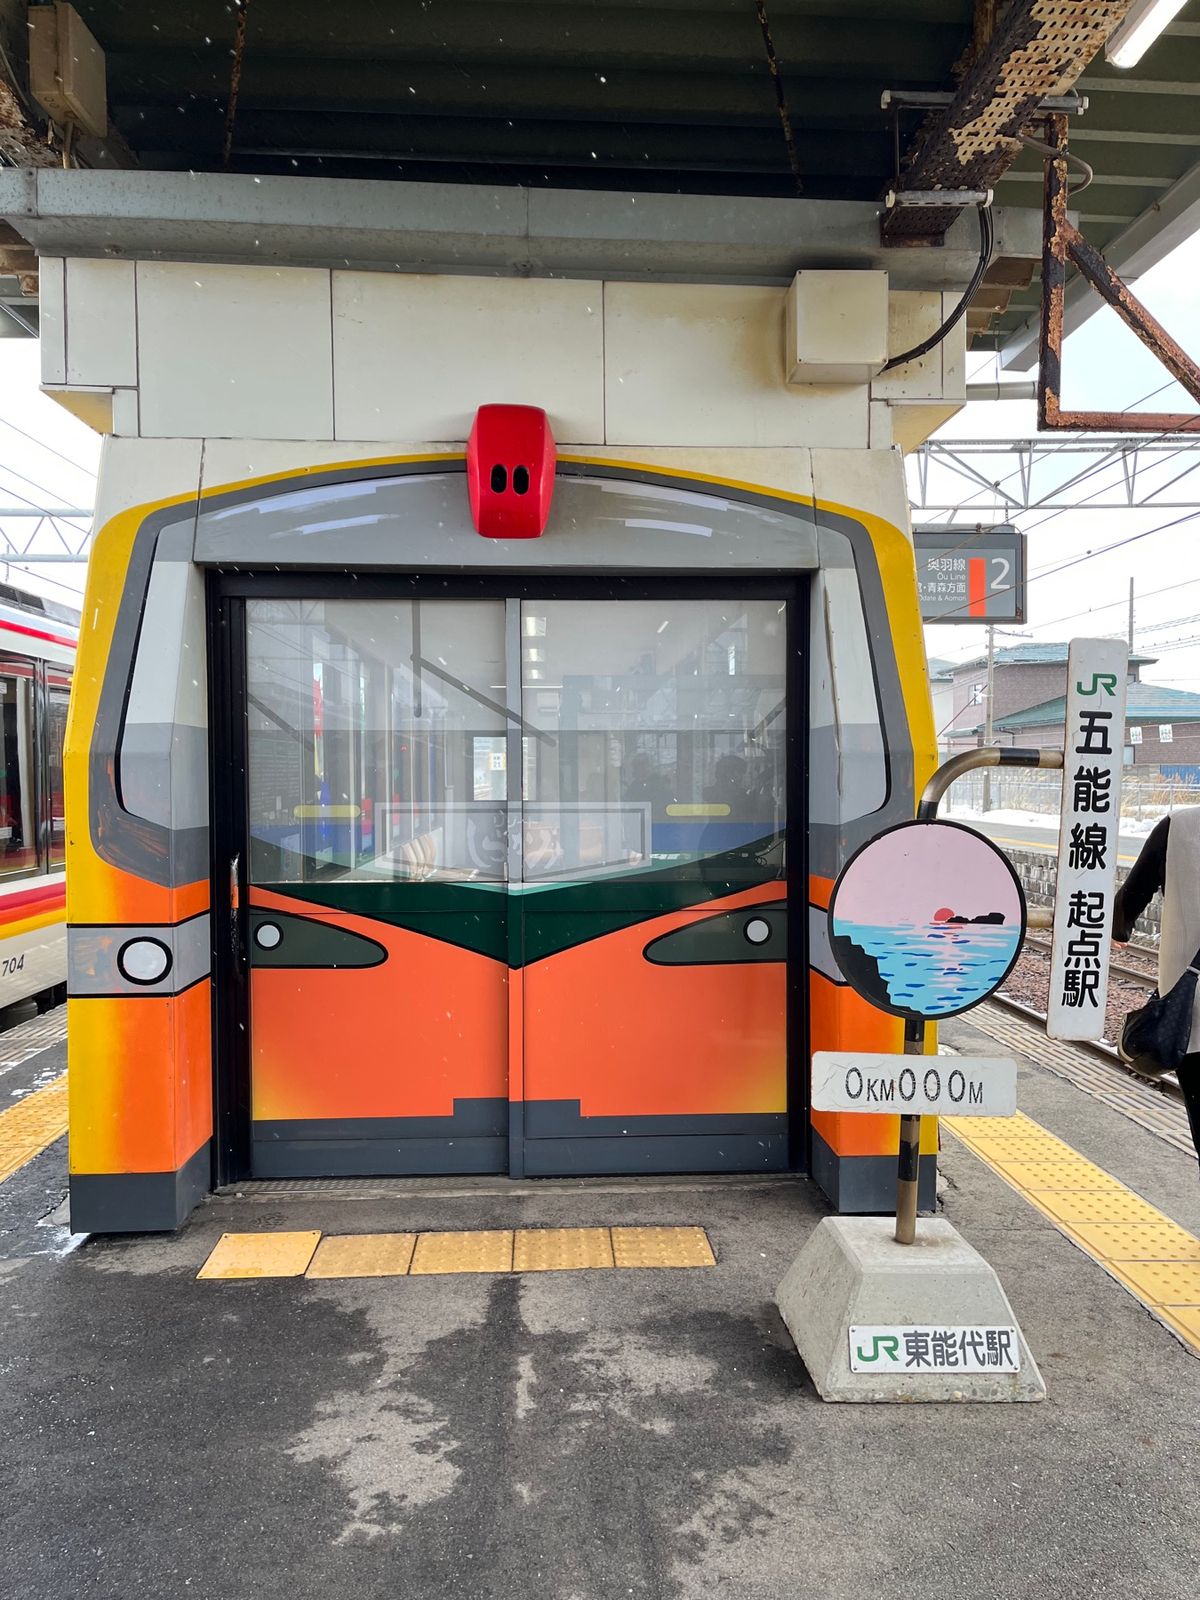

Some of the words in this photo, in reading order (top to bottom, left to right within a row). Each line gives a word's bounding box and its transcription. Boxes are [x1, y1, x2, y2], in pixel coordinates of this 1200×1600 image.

[927, 558, 966, 571] 奥羽線
[990, 557, 1011, 589] 2
[1076, 673, 1118, 697] JR
[2, 954, 25, 977] 704
[857, 1335, 900, 1362] JR
[903, 1330, 1014, 1368] 東能代駅
